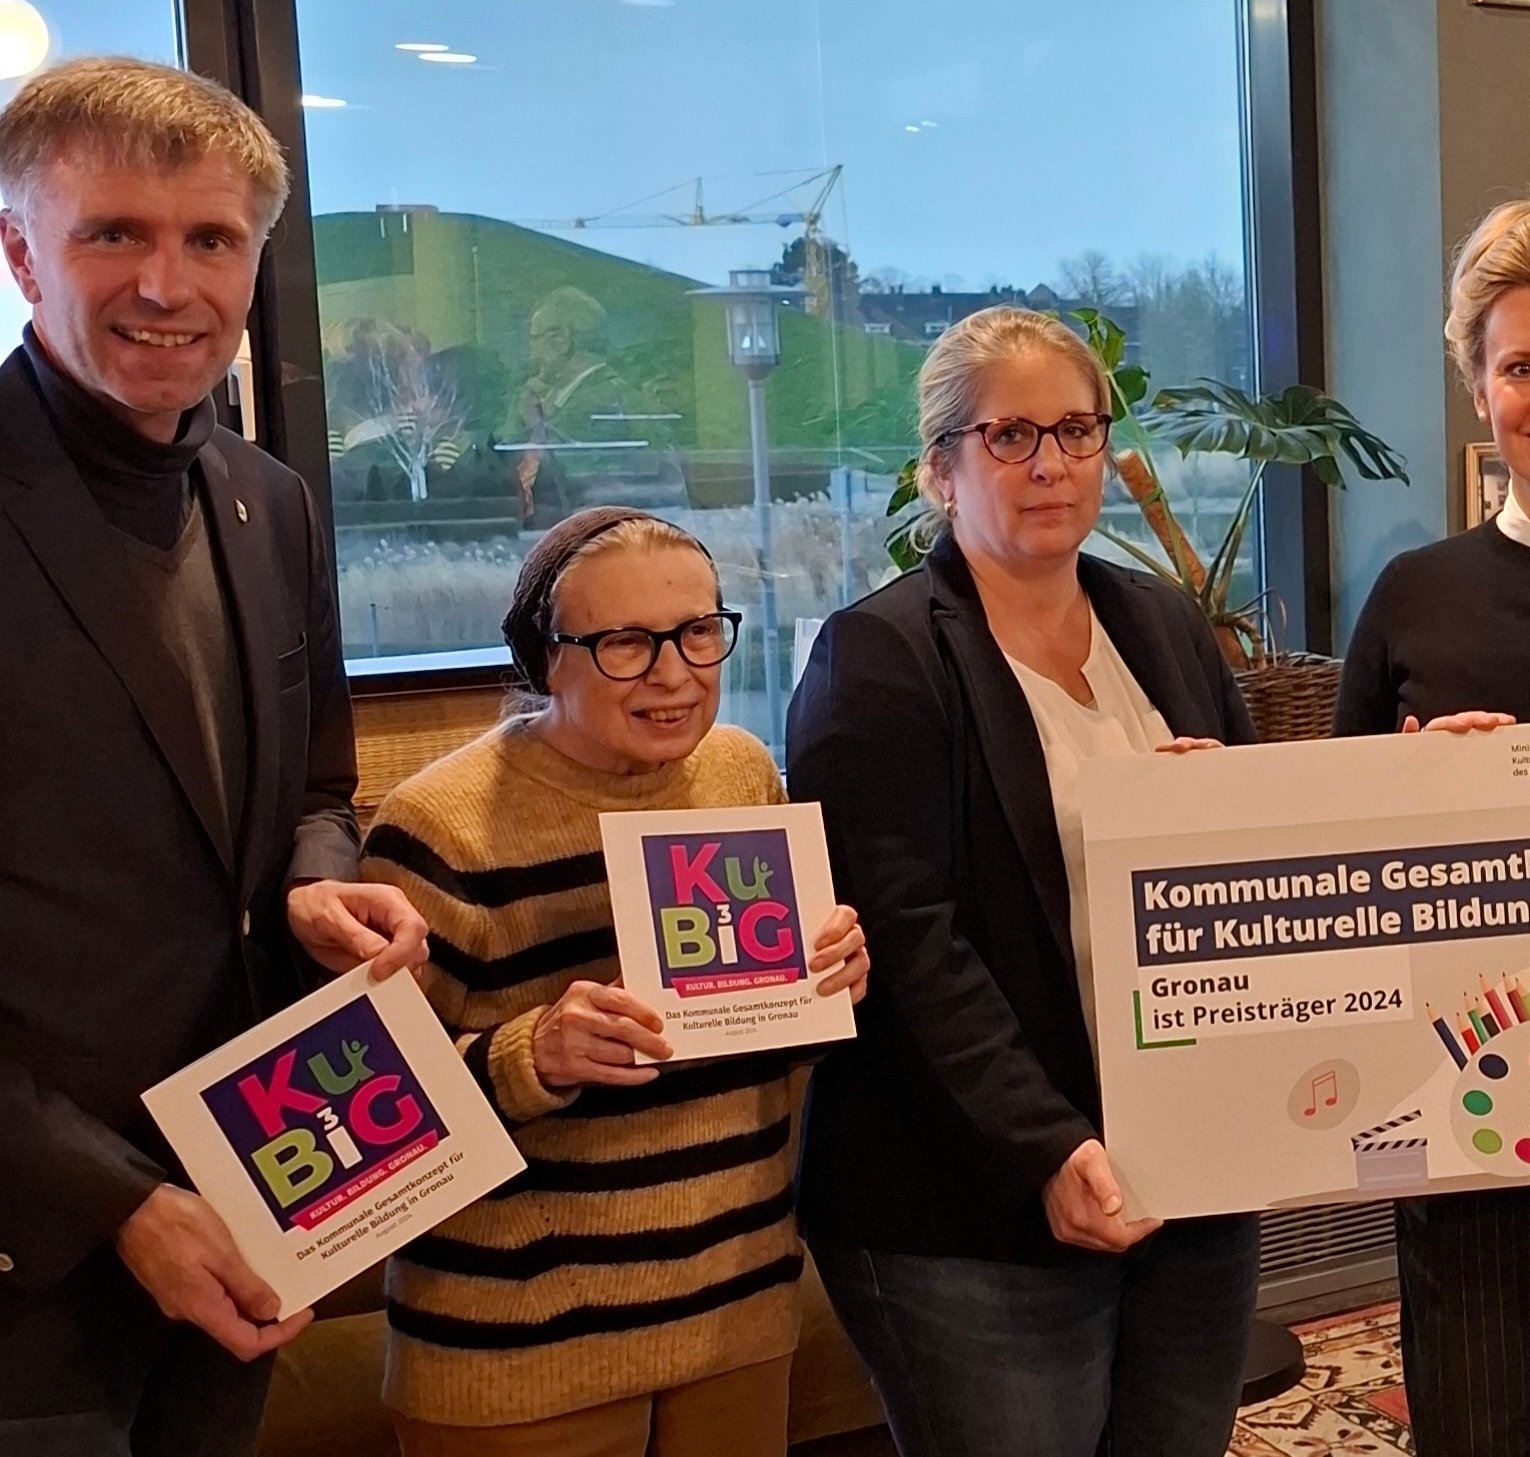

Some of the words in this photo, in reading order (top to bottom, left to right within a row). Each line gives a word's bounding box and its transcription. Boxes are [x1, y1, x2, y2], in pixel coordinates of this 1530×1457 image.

[1513, 766, 1528, 776] des
[1144, 864, 1371, 911] Kommunale
[1146, 922, 1203, 955] für
[1214, 906, 1401, 949] Kulturelle
[686, 982, 716, 991] KULTUR.
[718, 978, 753, 988] BILDUNG.
[754, 975, 788, 984] GRONAU.
[1151, 975, 1250, 997] Gronau
[683, 1006, 730, 1017] Kommunale
[733, 998, 797, 1012] Gesamtkonzept
[683, 1018, 722, 1030] Kulturelle
[725, 1015, 756, 1025] Bildung
[758, 1014, 766, 1022] in
[768, 1011, 798, 1020] Gronau
[1153, 1009, 1184, 1029] ist
[1193, 997, 1336, 1026] Preisträger
[1344, 989, 1402, 1013] 2024
[309, 1194, 347, 1220] KULTUR.
[346, 1170, 388, 1196] BILDUNG.
[388, 1144, 428, 1170] GRONAU.
[296, 1246, 316, 1260] Das
[316, 1209, 373, 1247] Kommunale
[375, 1162, 449, 1210] Gesamtkonzept
[449, 1152, 464, 1165] für
[320, 1226, 369, 1259] Kulturelle
[369, 1202, 408, 1228] Bildung
[408, 1196, 418, 1206] in
[419, 1174, 454, 1198] Gronau
